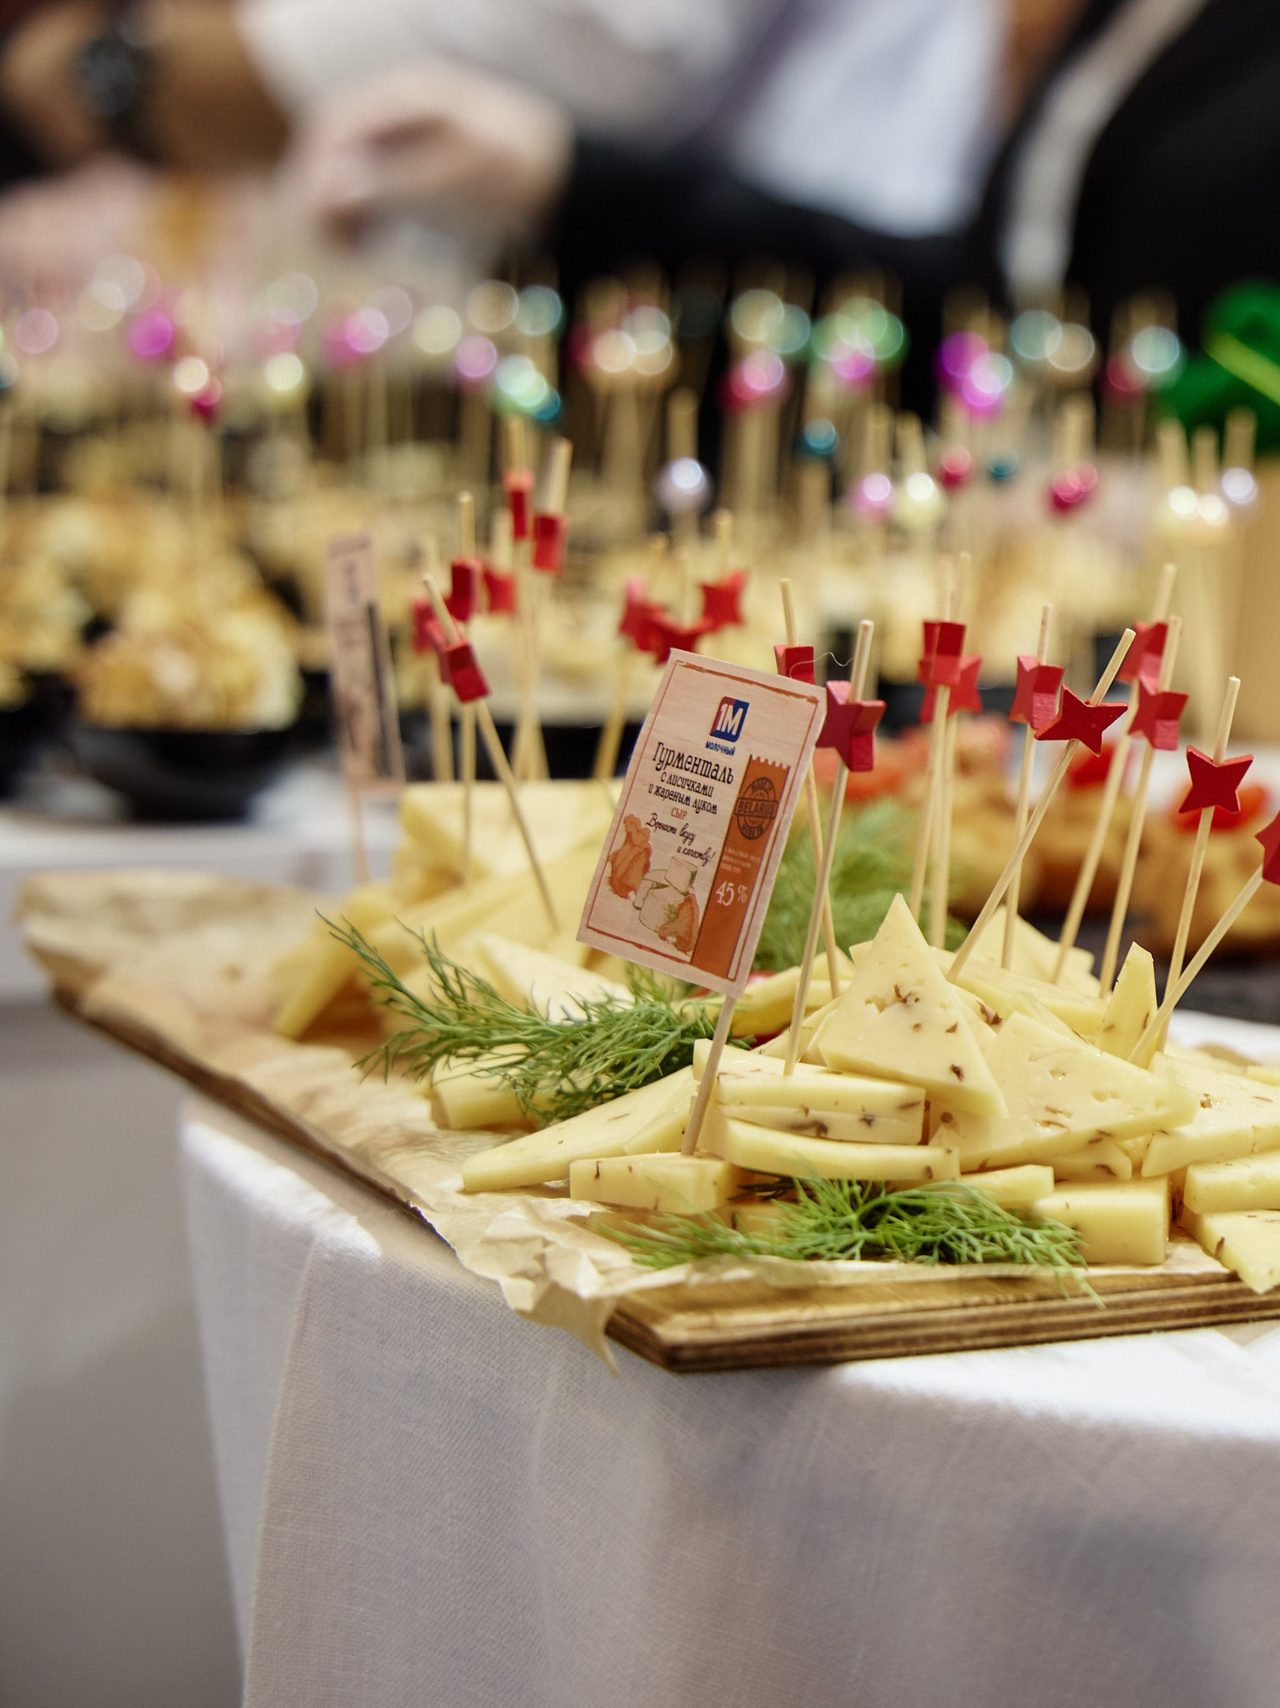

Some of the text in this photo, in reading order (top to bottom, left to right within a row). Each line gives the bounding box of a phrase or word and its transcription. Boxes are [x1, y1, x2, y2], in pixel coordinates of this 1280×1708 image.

[652, 741, 734, 785] Гурменталь
[666, 773, 714, 798] лисичками
[653, 785, 691, 802] жареным
[692, 798, 718, 815] луком
[737, 799, 776, 817] BELARUS
